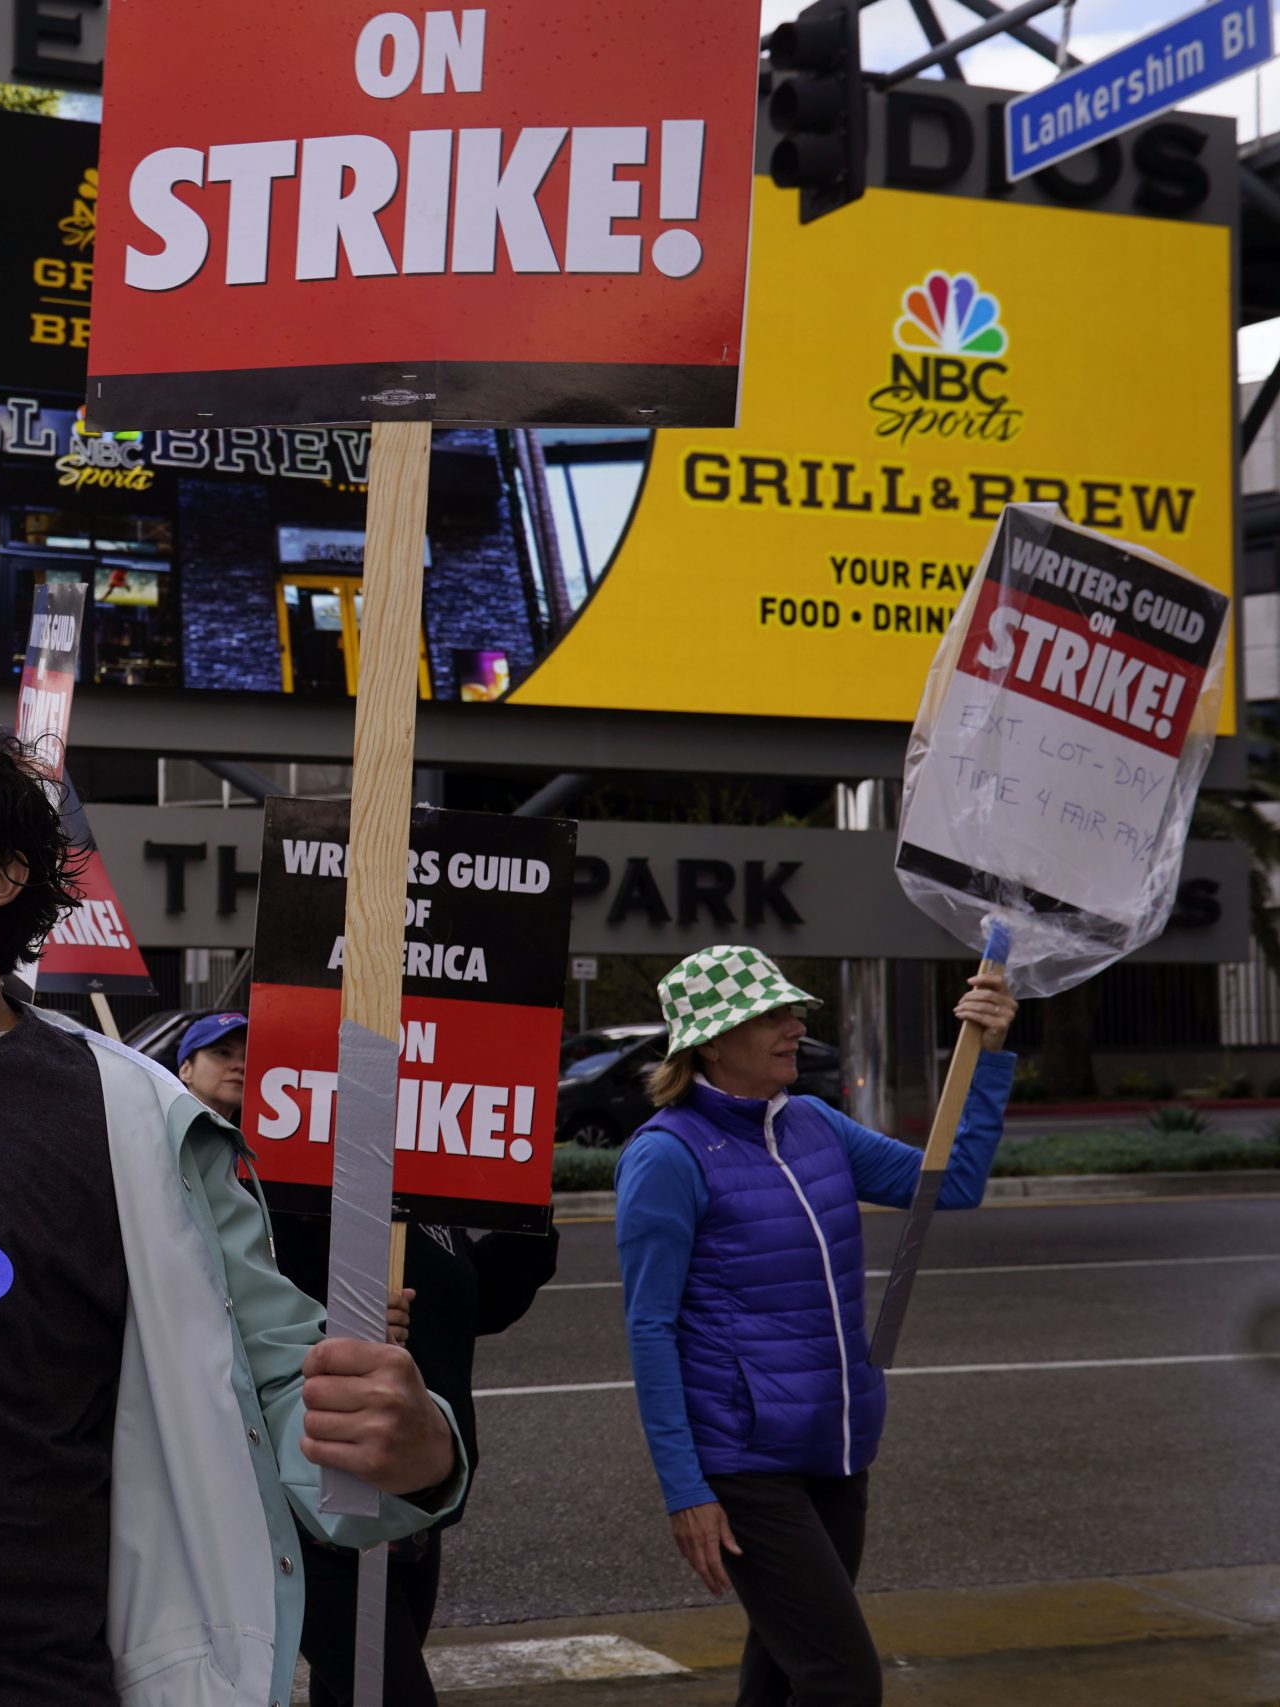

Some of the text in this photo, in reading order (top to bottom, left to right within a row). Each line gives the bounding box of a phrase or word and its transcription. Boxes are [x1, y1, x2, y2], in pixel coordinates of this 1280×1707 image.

[355, 8, 487, 99] ON
[1021, 8, 1257, 155] Lankershim Bl
[124, 119, 705, 291] STRIKE!
[892, 353, 1008, 403] NBC
[869, 385, 1024, 448] Sports
[55, 454, 155, 494] Sports
[70, 436, 144, 468] NBC
[830, 556, 910, 588] YOUR
[1012, 537, 1206, 645] WRITERS GUILD
[761, 597, 957, 634] FOOD DRIN
[1089, 611, 1117, 637] ON
[977, 606, 1186, 740] STRIKE!
[949, 755, 1020, 805] TIME
[1037, 789, 1052, 816] 4
[1060, 802, 1107, 840] FAIR
[448, 852, 551, 894] GUILD
[573, 856, 805, 926] PARK
[42, 900, 131, 950] RIKE!
[327, 935, 488, 982] ARICA
[257, 1067, 535, 1162] STIKE!
